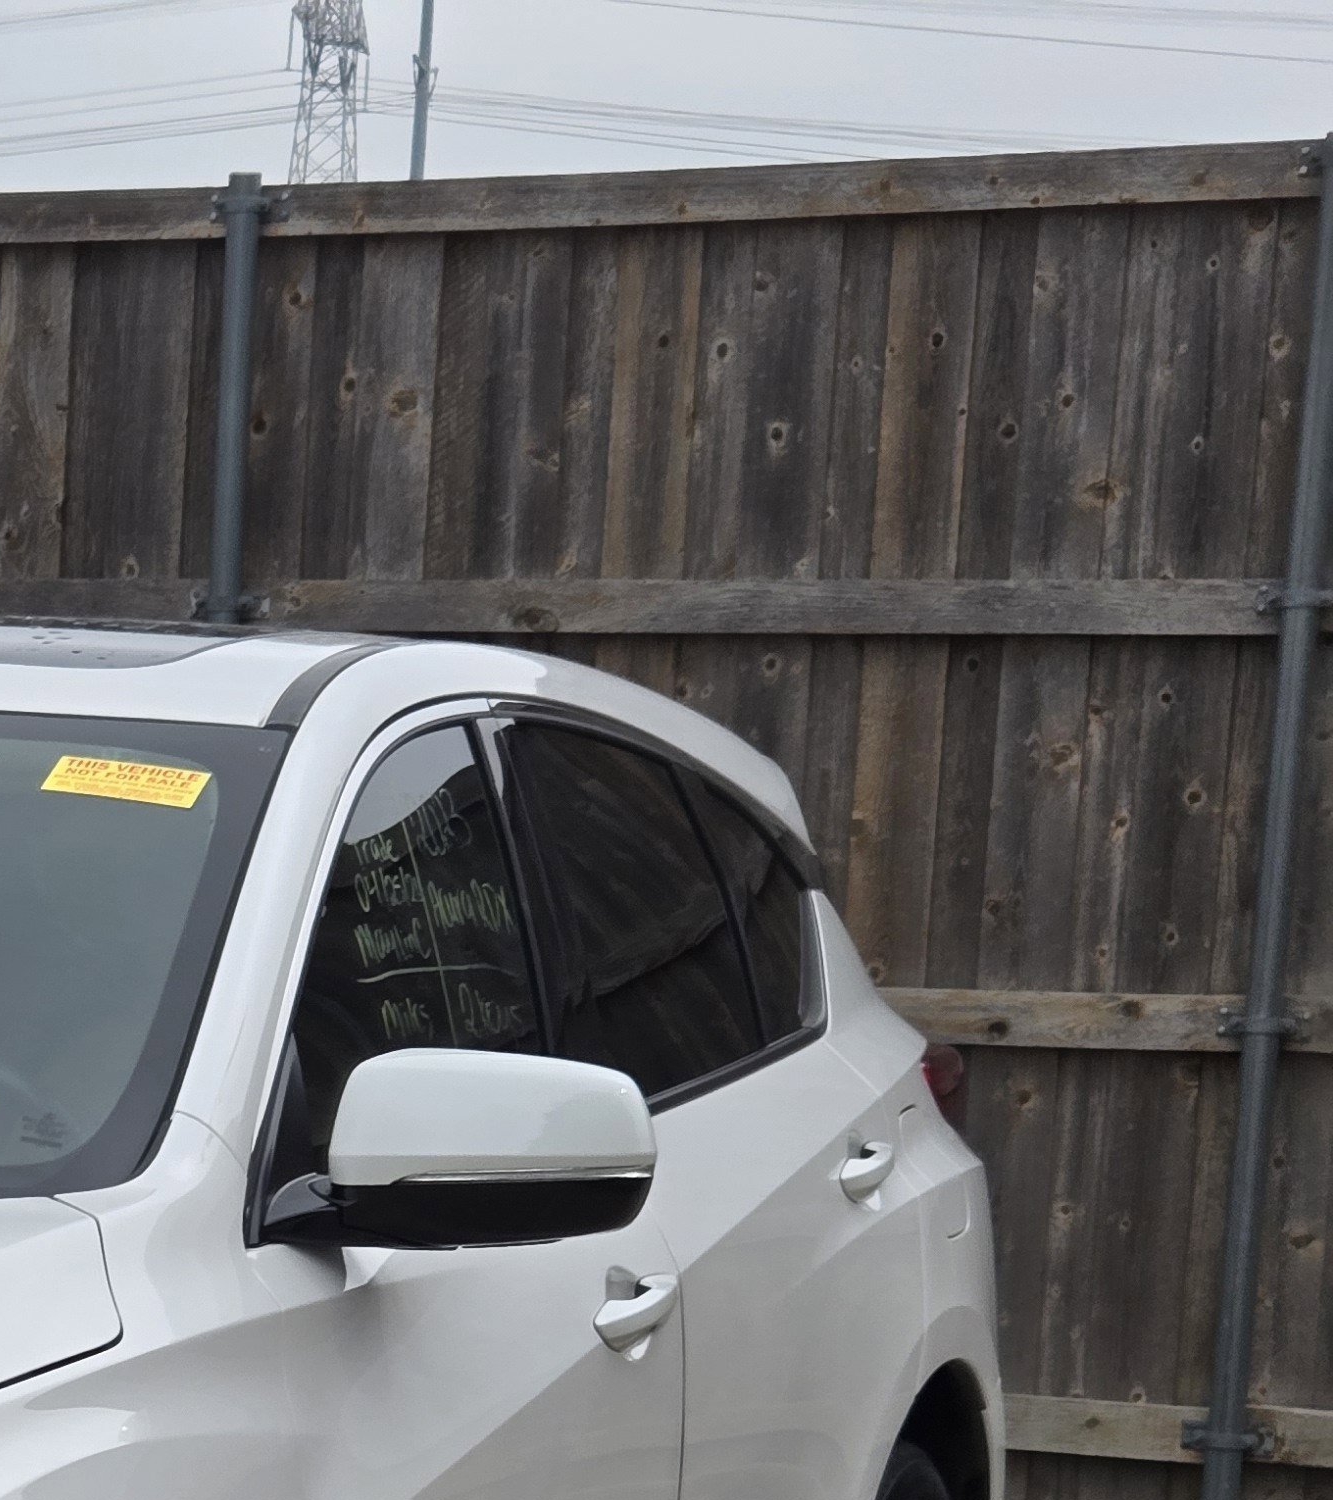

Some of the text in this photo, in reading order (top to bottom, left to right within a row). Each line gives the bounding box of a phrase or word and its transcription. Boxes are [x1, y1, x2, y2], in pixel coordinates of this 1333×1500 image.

[64, 767, 99, 778] NOT
[104, 772, 141, 782] FOR
[146, 777, 191, 788] SALE
[66, 758, 202, 783] THIS VEHICLE
